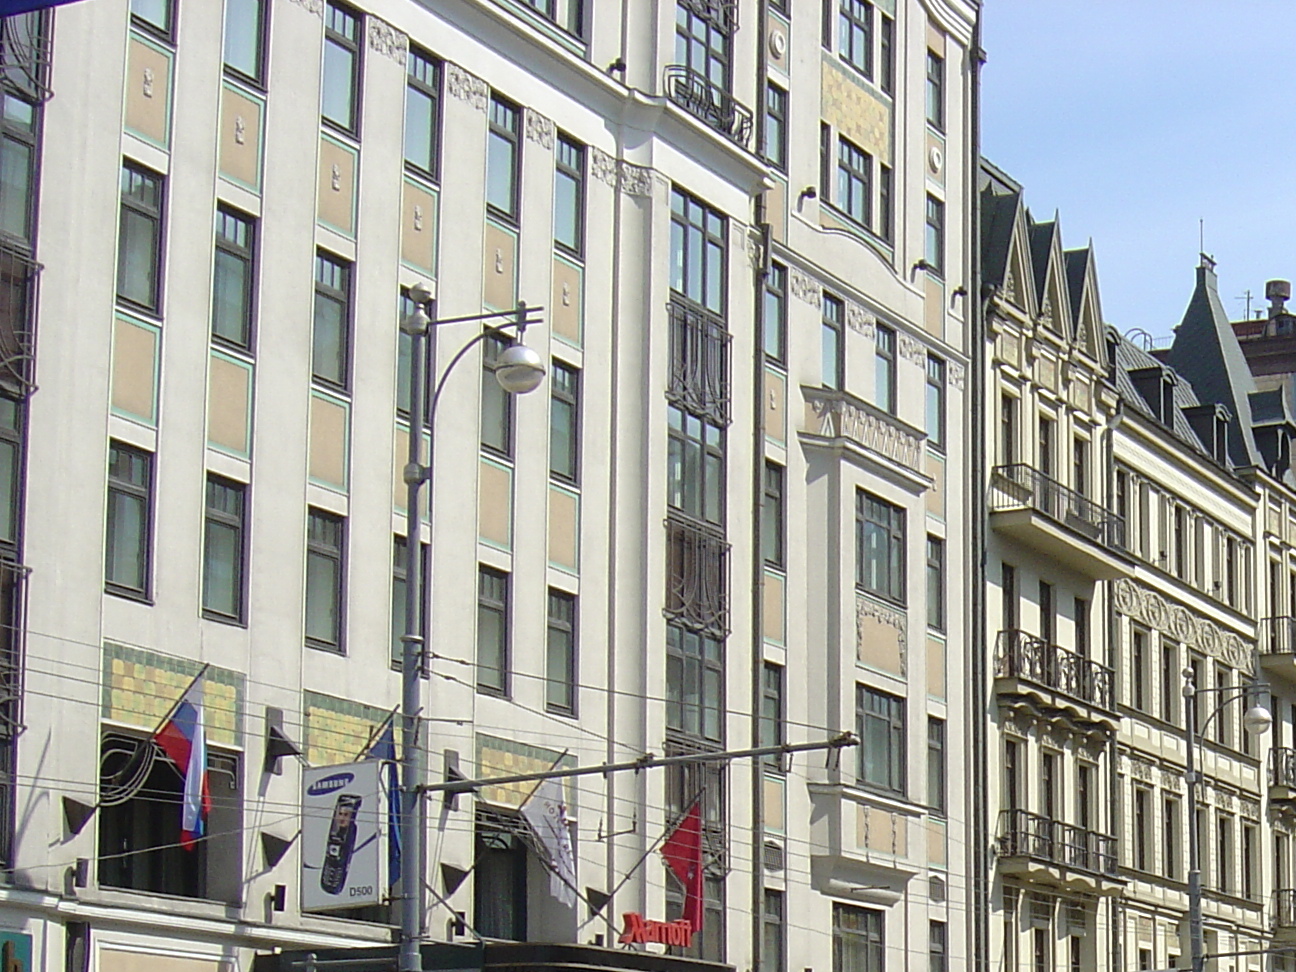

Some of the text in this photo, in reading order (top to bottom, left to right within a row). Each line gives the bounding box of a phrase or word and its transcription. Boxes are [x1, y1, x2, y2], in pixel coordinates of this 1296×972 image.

[311, 778, 351, 791] SAMSUNG
[349, 886, 374, 897] D500
[618, 912, 692, 947] Marriott
